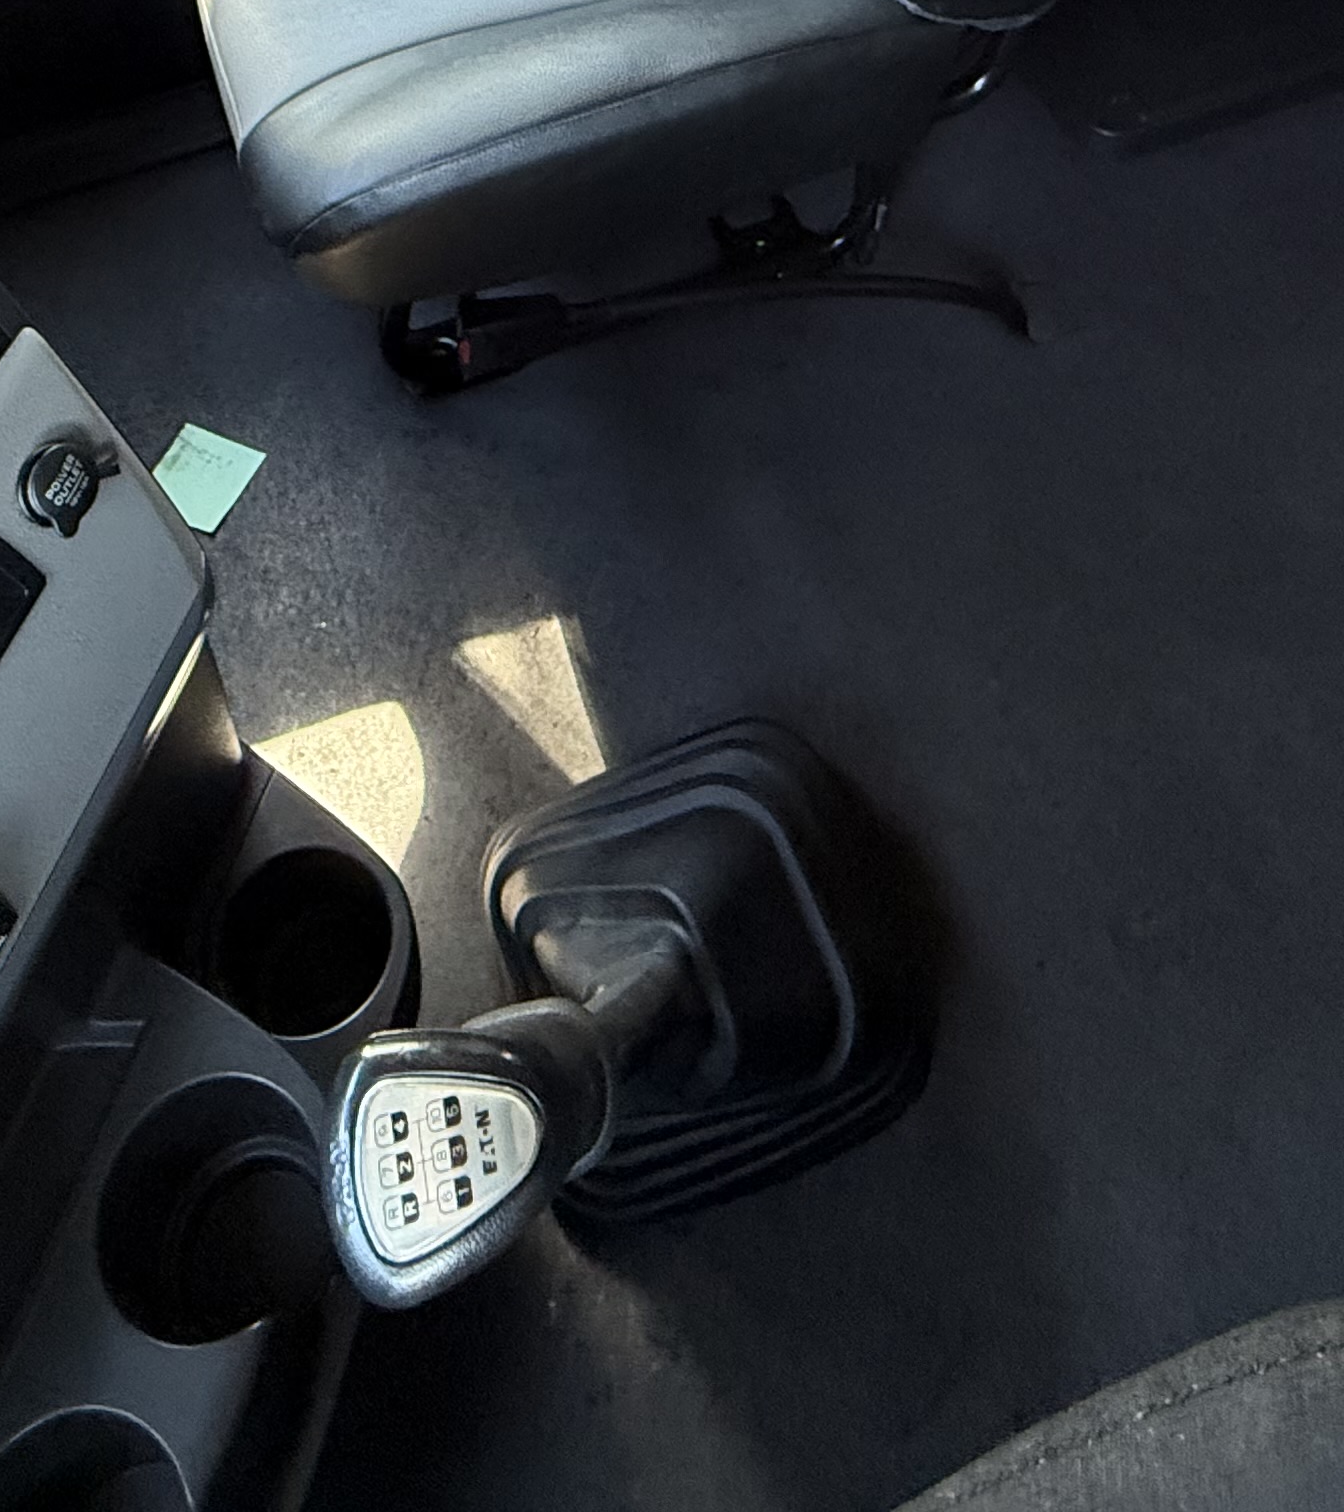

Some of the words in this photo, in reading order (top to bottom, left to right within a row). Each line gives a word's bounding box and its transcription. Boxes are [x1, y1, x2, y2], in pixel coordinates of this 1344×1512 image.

[45, 453, 75, 500] POWER
[54, 459, 83, 506] OUTLET
[430, 1107, 442, 1125] 10
[446, 1105, 459, 1118] 5
[393, 1118, 407, 1133] 4
[436, 1148, 447, 1161] 8
[452, 1144, 465, 1158] 3
[382, 1167, 394, 1178] 7
[399, 1159, 413, 1176] 2
[441, 1191, 454, 1204] 6
[388, 1207, 399, 1220] R
[405, 1202, 419, 1216] R
